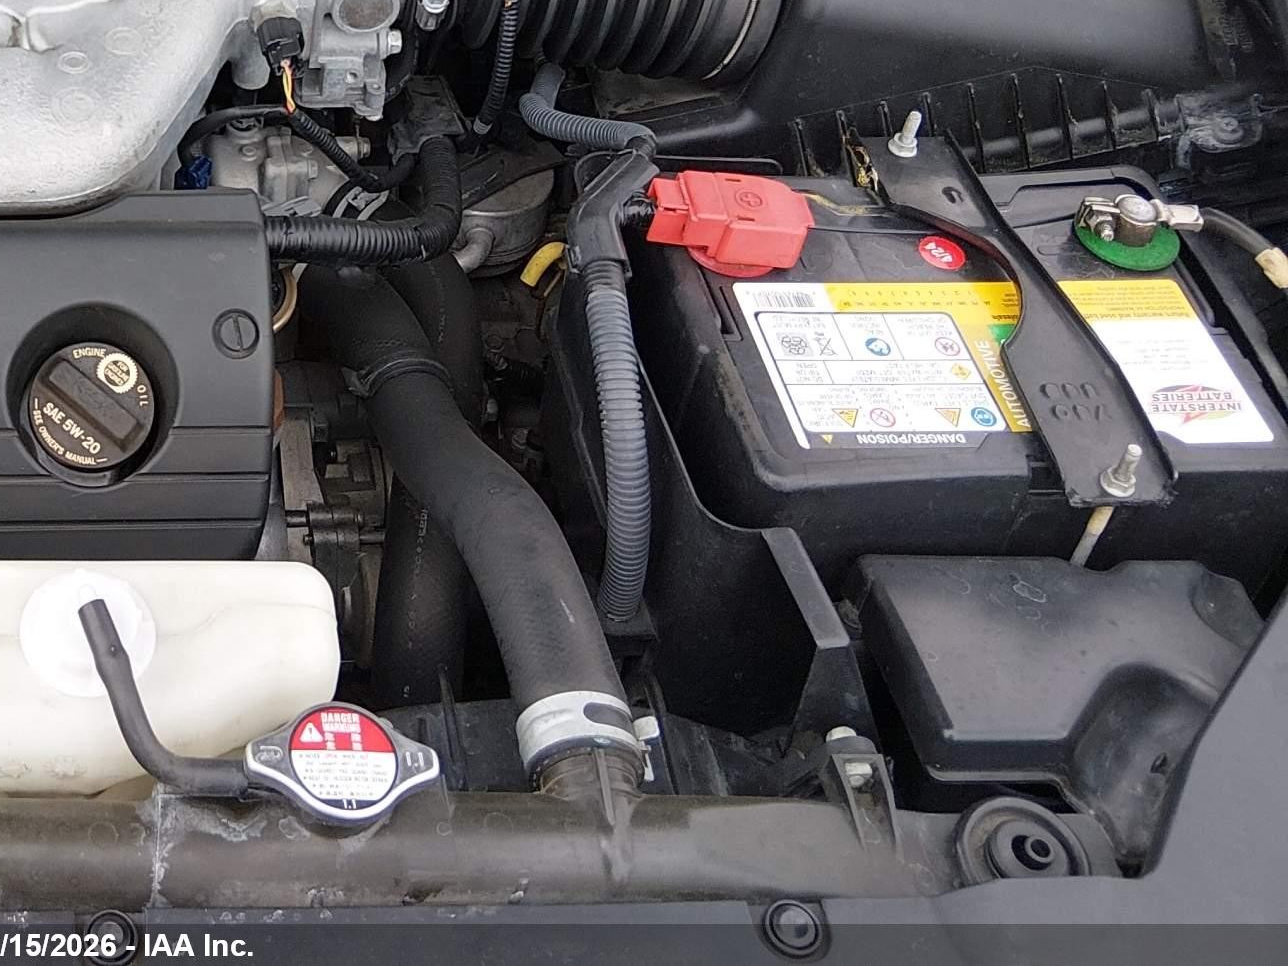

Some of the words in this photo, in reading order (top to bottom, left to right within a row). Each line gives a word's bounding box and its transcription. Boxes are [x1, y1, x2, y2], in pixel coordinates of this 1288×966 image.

[73, 347, 106, 359] ENGINE
[974, 338, 1032, 428] AUTOMOTIVE
[137, 384, 150, 408] OIL
[1153, 392, 1233, 402] BATTERIES
[1152, 402, 1242, 413] INTERSTATE
[43, 402, 66, 424] SAE
[62, 419, 101, 454] 5W-20
[856, 433, 967, 445] DANGER/POISON
[64, 450, 97, 465] MANUAL
[320, 712, 360, 722] DANGER
[342, 798, 357, 810] 1.1
